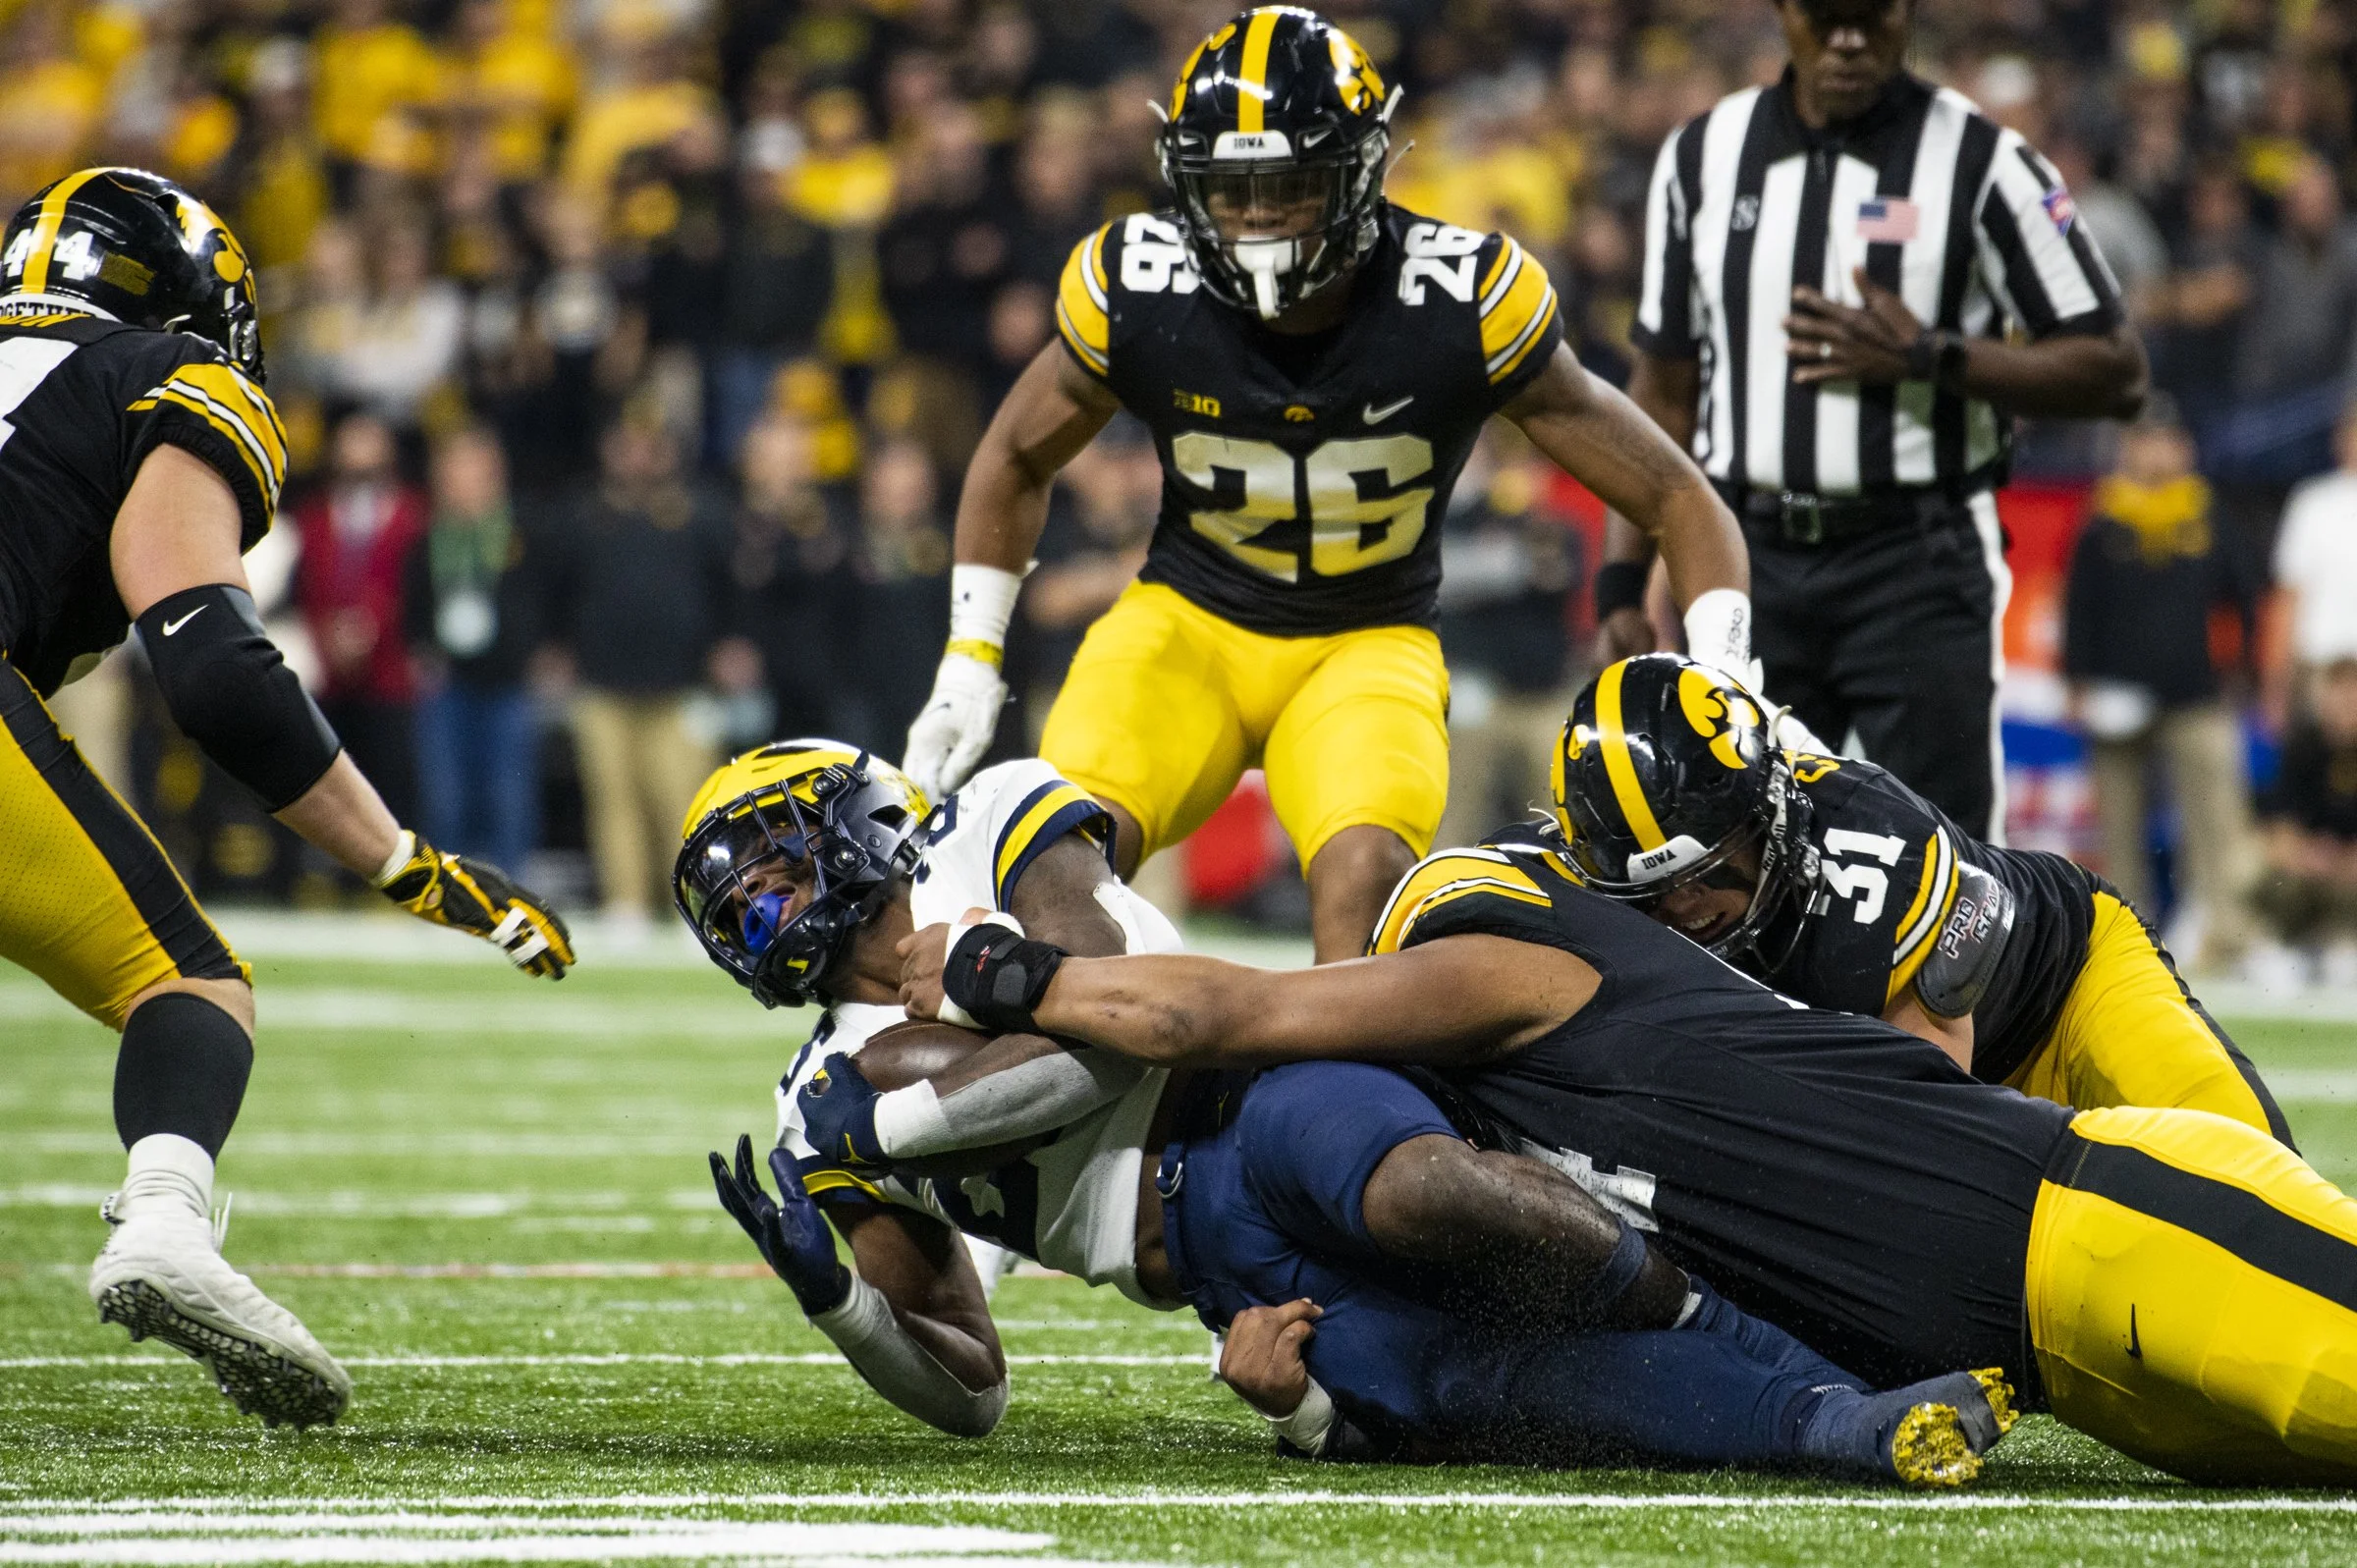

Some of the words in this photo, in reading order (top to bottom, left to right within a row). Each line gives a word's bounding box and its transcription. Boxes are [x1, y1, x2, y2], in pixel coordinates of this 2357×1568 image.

[1233, 137, 1266, 150] IOWA
[3, 228, 95, 281] 44
[1398, 223, 1486, 305] 26
[1173, 432, 1435, 584] 26
[1640, 848, 1677, 870] IOWA
[1812, 828, 1906, 924] 31
[1938, 896, 1977, 959] PRO
